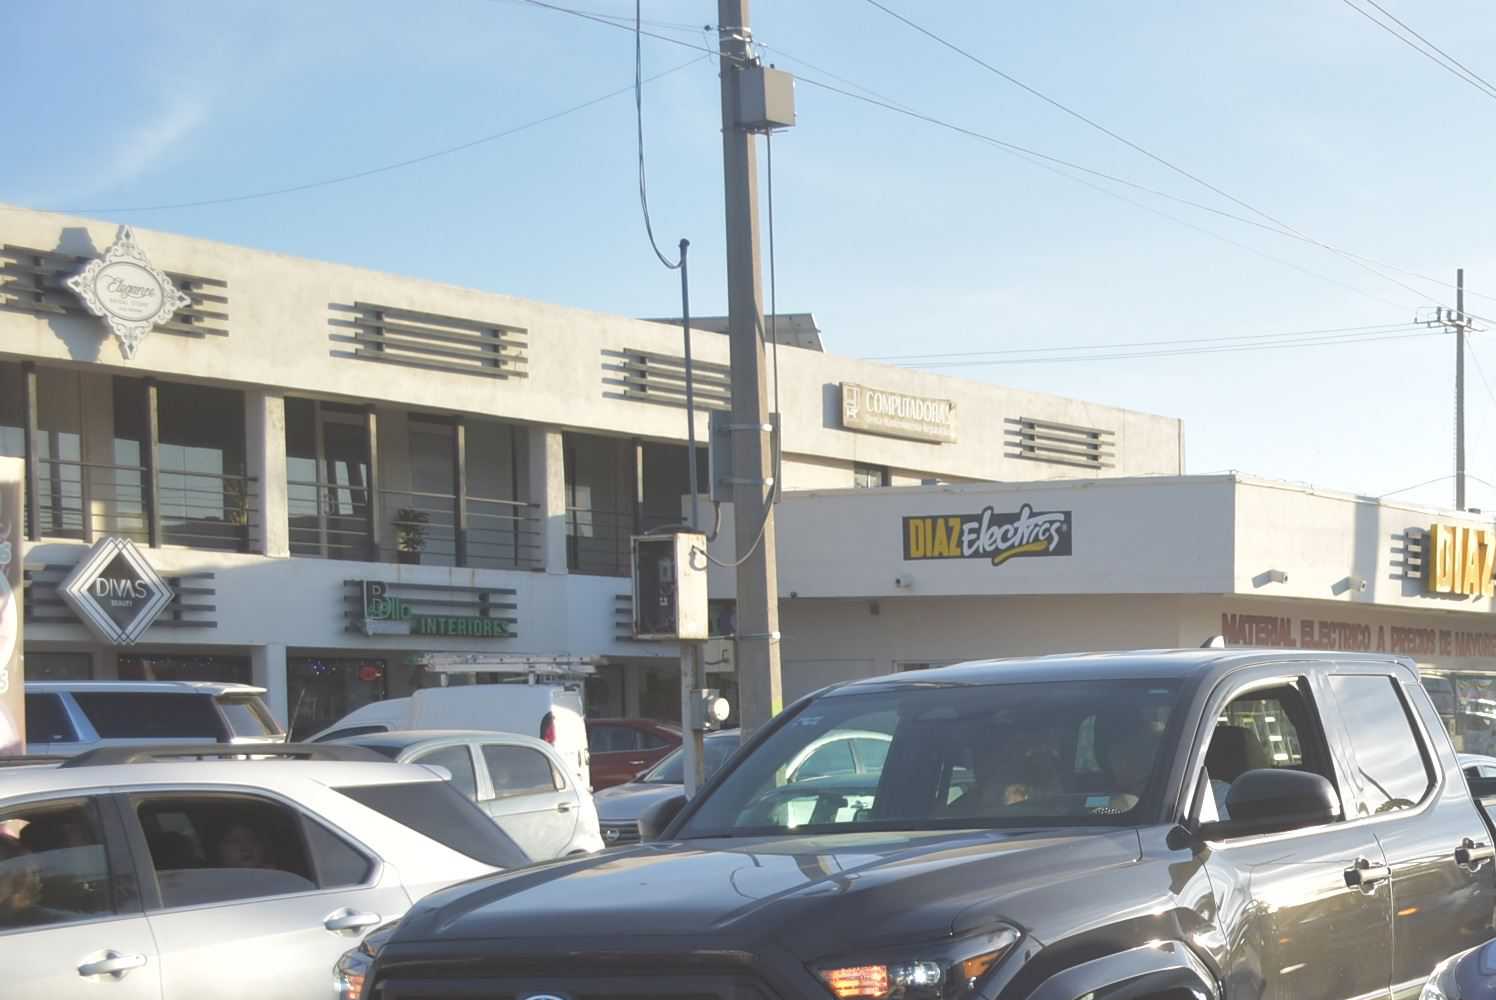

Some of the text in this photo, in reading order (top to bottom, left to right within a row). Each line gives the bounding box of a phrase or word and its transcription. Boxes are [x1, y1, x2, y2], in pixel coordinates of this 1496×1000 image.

[909, 505, 1065, 558] DIAZ Electrics
[1431, 524, 1496, 597] DIAZ
[96, 577, 146, 599] DIVAS
[1222, 613, 1297, 646] MATERIAL
